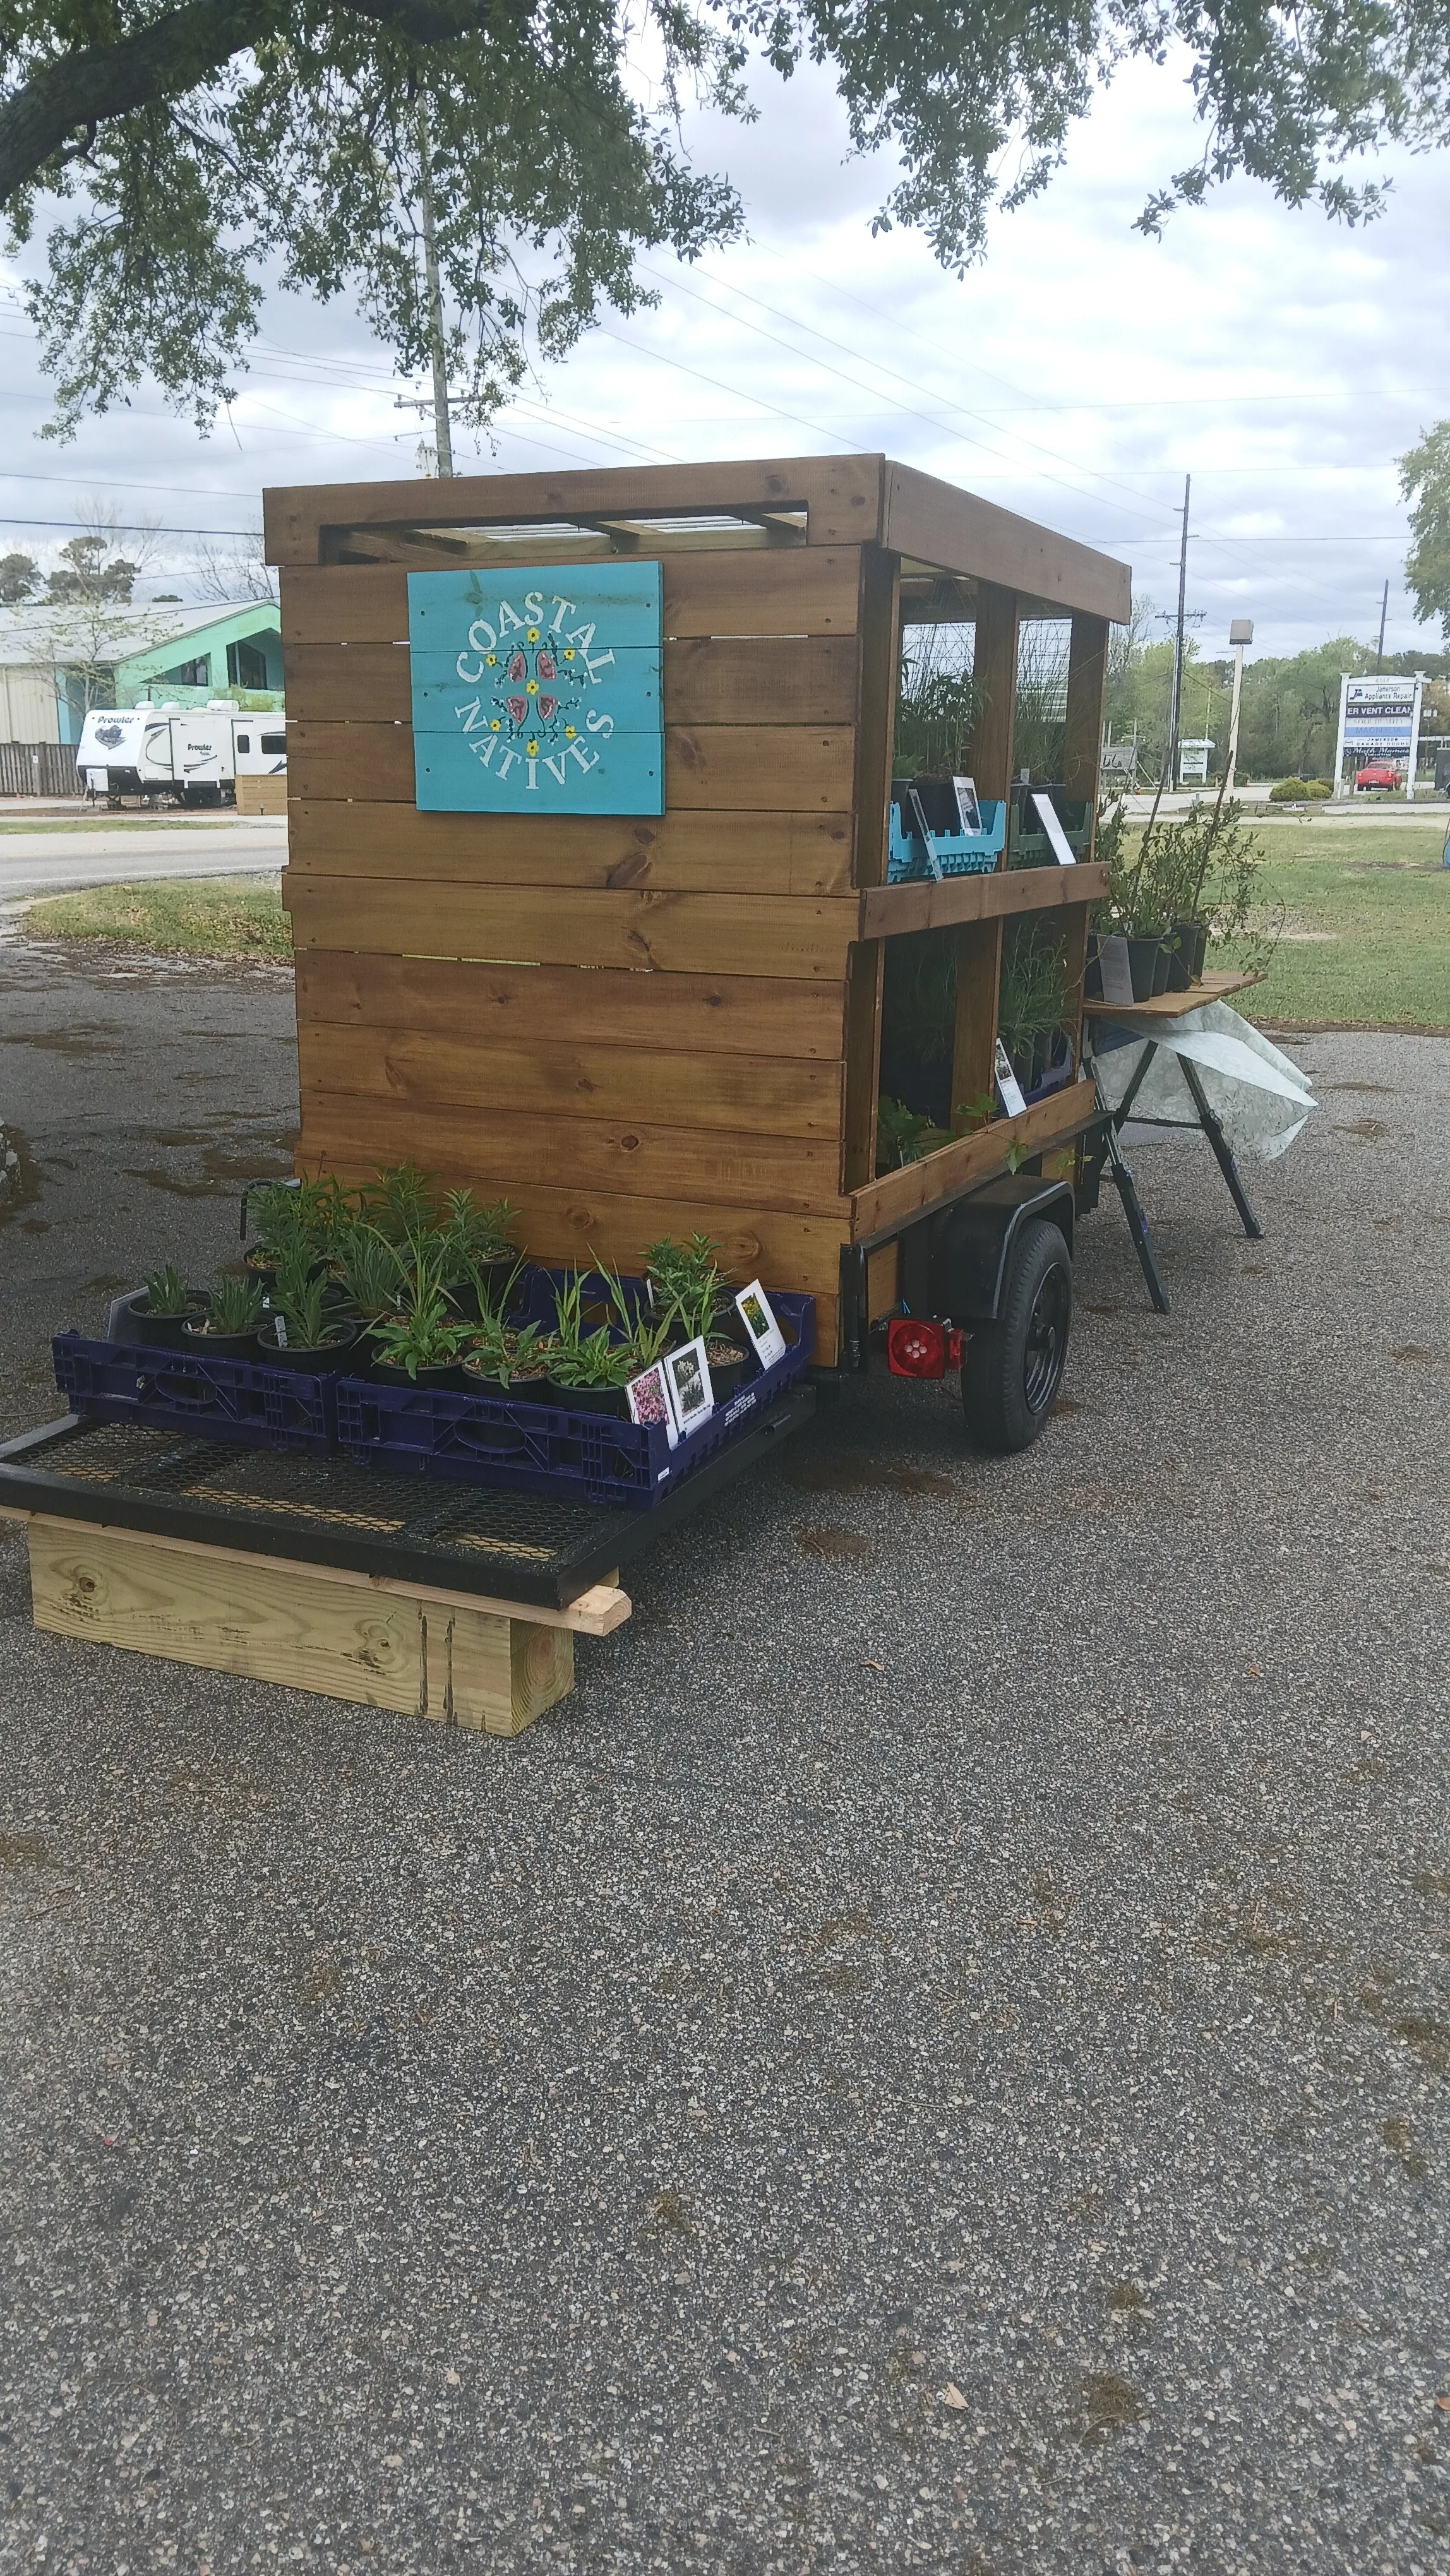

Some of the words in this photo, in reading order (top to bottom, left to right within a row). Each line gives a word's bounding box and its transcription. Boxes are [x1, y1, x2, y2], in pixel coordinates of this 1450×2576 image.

[456, 591, 617, 685] COASTAL
[1361, 707, 1383, 715] VENT
[1393, 692, 1412, 700] Repair
[454, 696, 614, 790] NATIVES
